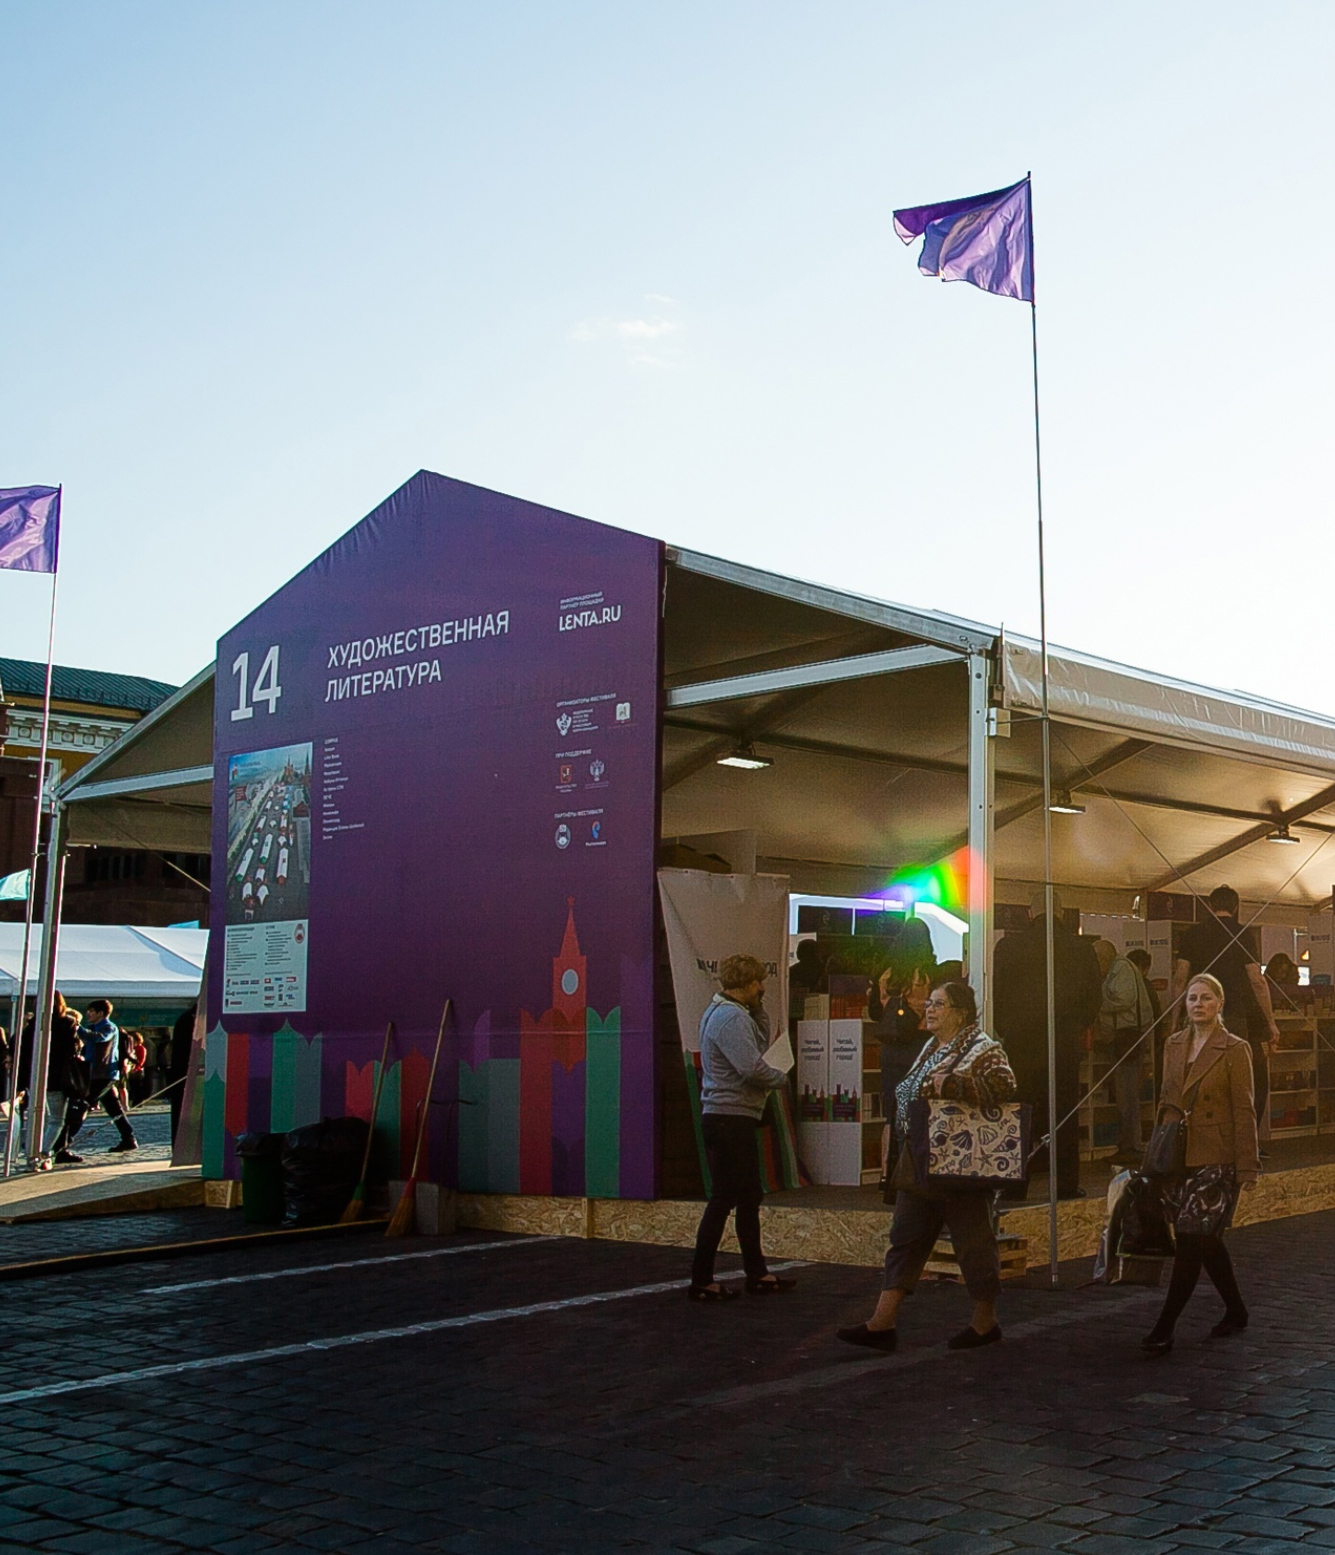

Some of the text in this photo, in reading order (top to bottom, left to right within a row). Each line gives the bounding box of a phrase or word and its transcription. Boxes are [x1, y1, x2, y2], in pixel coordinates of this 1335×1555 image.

[327, 610, 510, 669] ХУДОЖЕСТВЕННАЯ
[559, 605, 622, 632] LENTA.RU
[231, 645, 282, 721] 14
[324, 659, 442, 703] ЛИТЕРАТУРА
